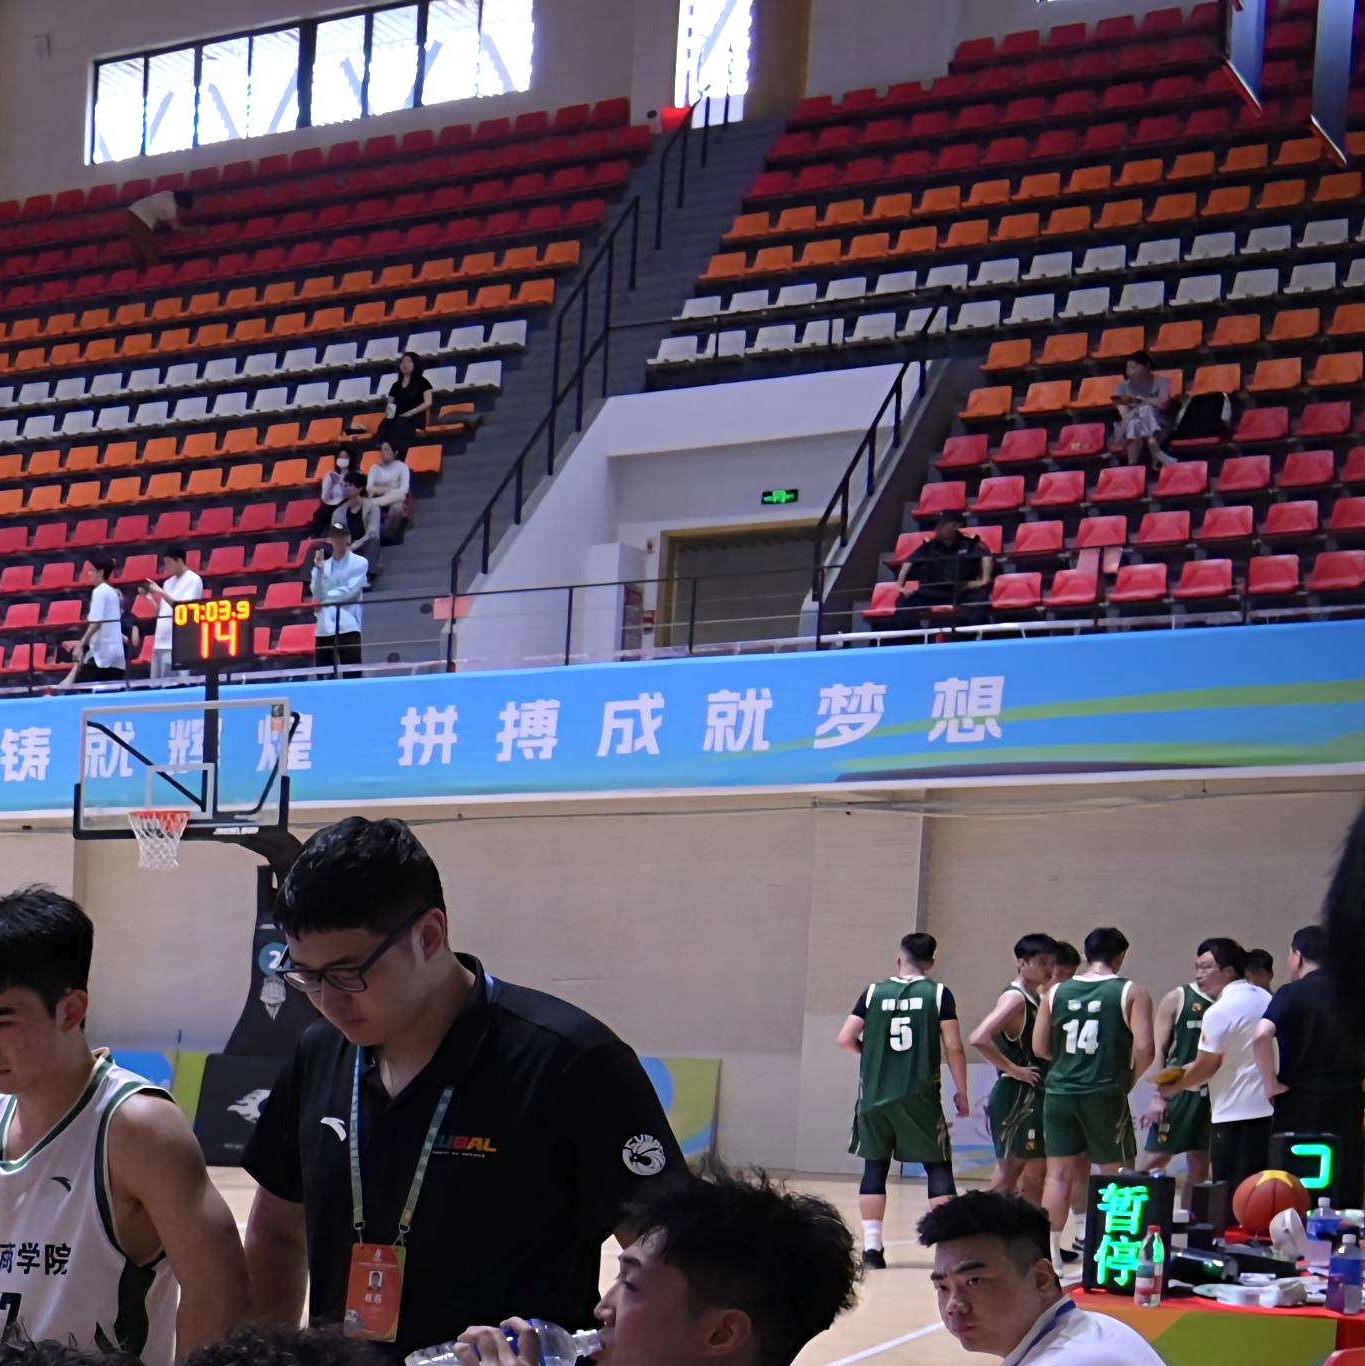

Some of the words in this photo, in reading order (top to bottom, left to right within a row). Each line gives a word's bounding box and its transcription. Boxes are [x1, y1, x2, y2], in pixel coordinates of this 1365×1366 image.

[174, 600, 250, 626] 07:03.9
[201, 619, 237, 659] 14
[398, 675, 1005, 767] 拼搏成就梦想
[889, 1016, 914, 1052] 5
[1062, 1019, 1100, 1055] 14
[1093, 1182, 1150, 1287] 暂停
